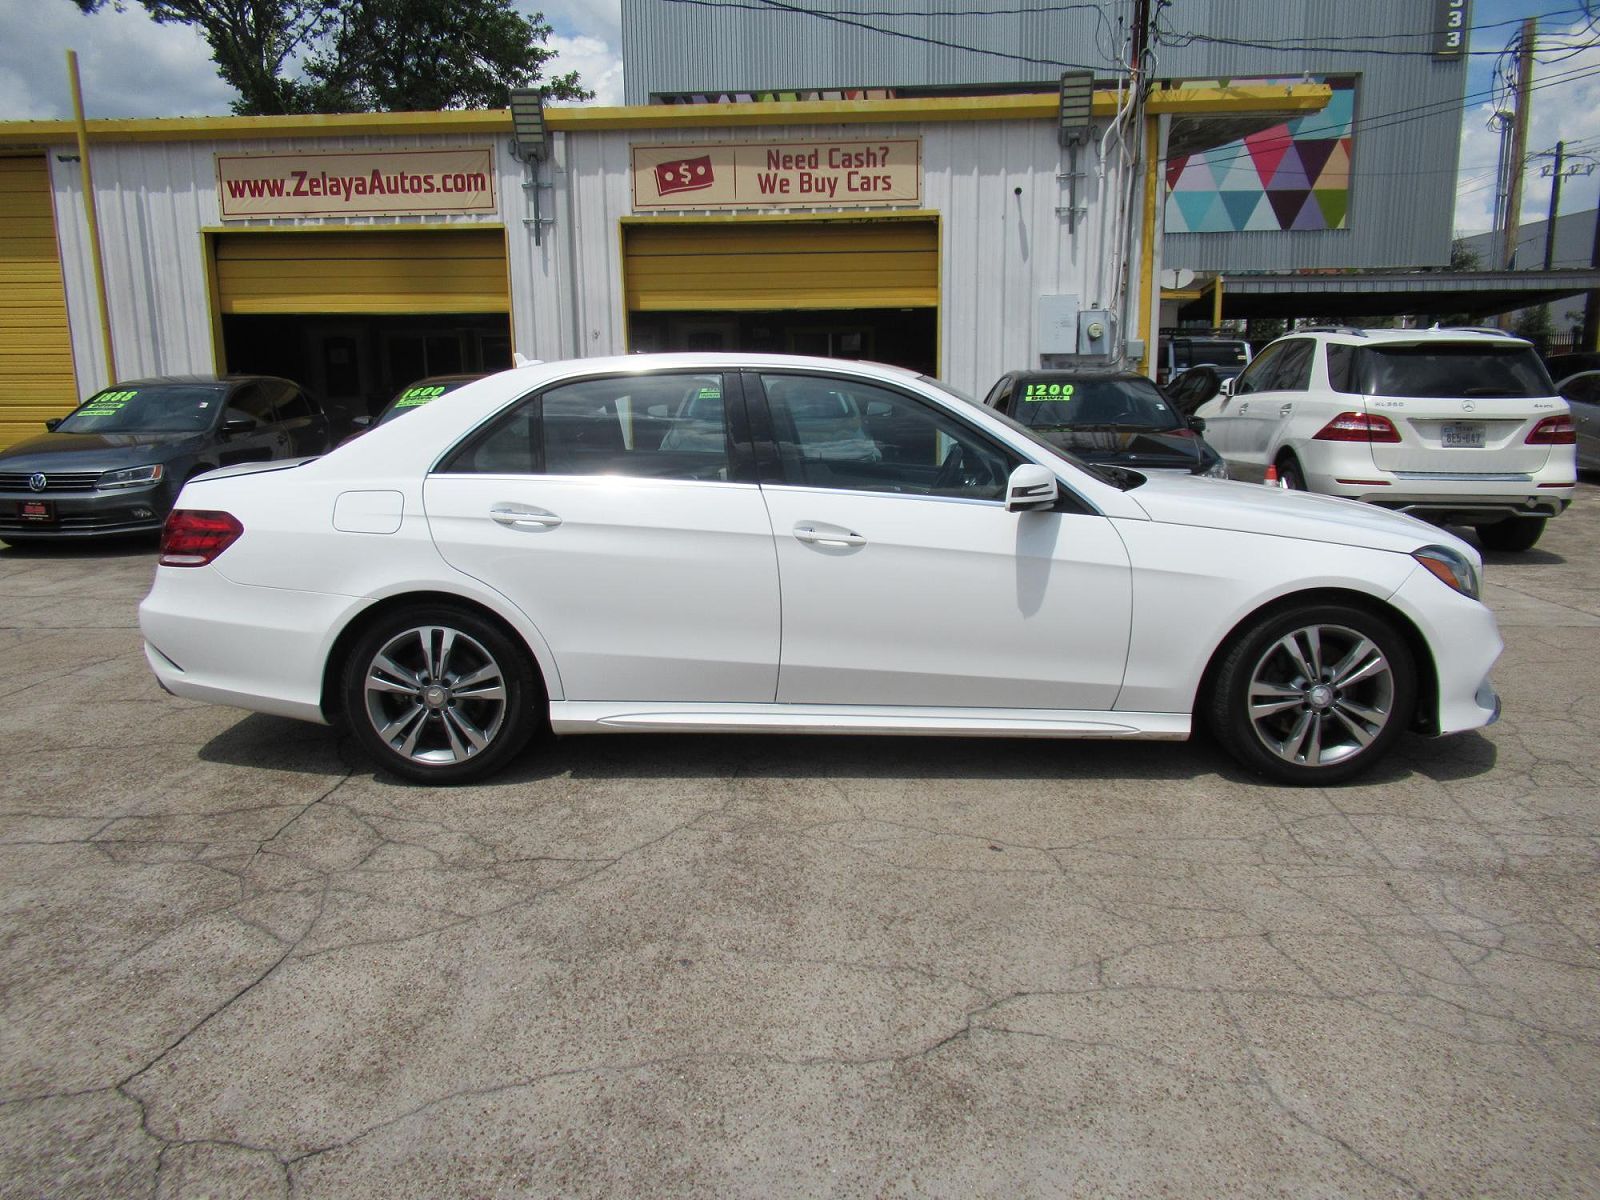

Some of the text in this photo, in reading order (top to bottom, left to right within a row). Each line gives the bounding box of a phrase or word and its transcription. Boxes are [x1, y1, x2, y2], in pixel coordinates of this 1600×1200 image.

[767, 146, 889, 170] Need Cash?
[226, 168, 486, 202] www.ZelayaAutos.com
[757, 171, 892, 197] We Buy Cars
[1026, 384, 1074, 396] 1200
